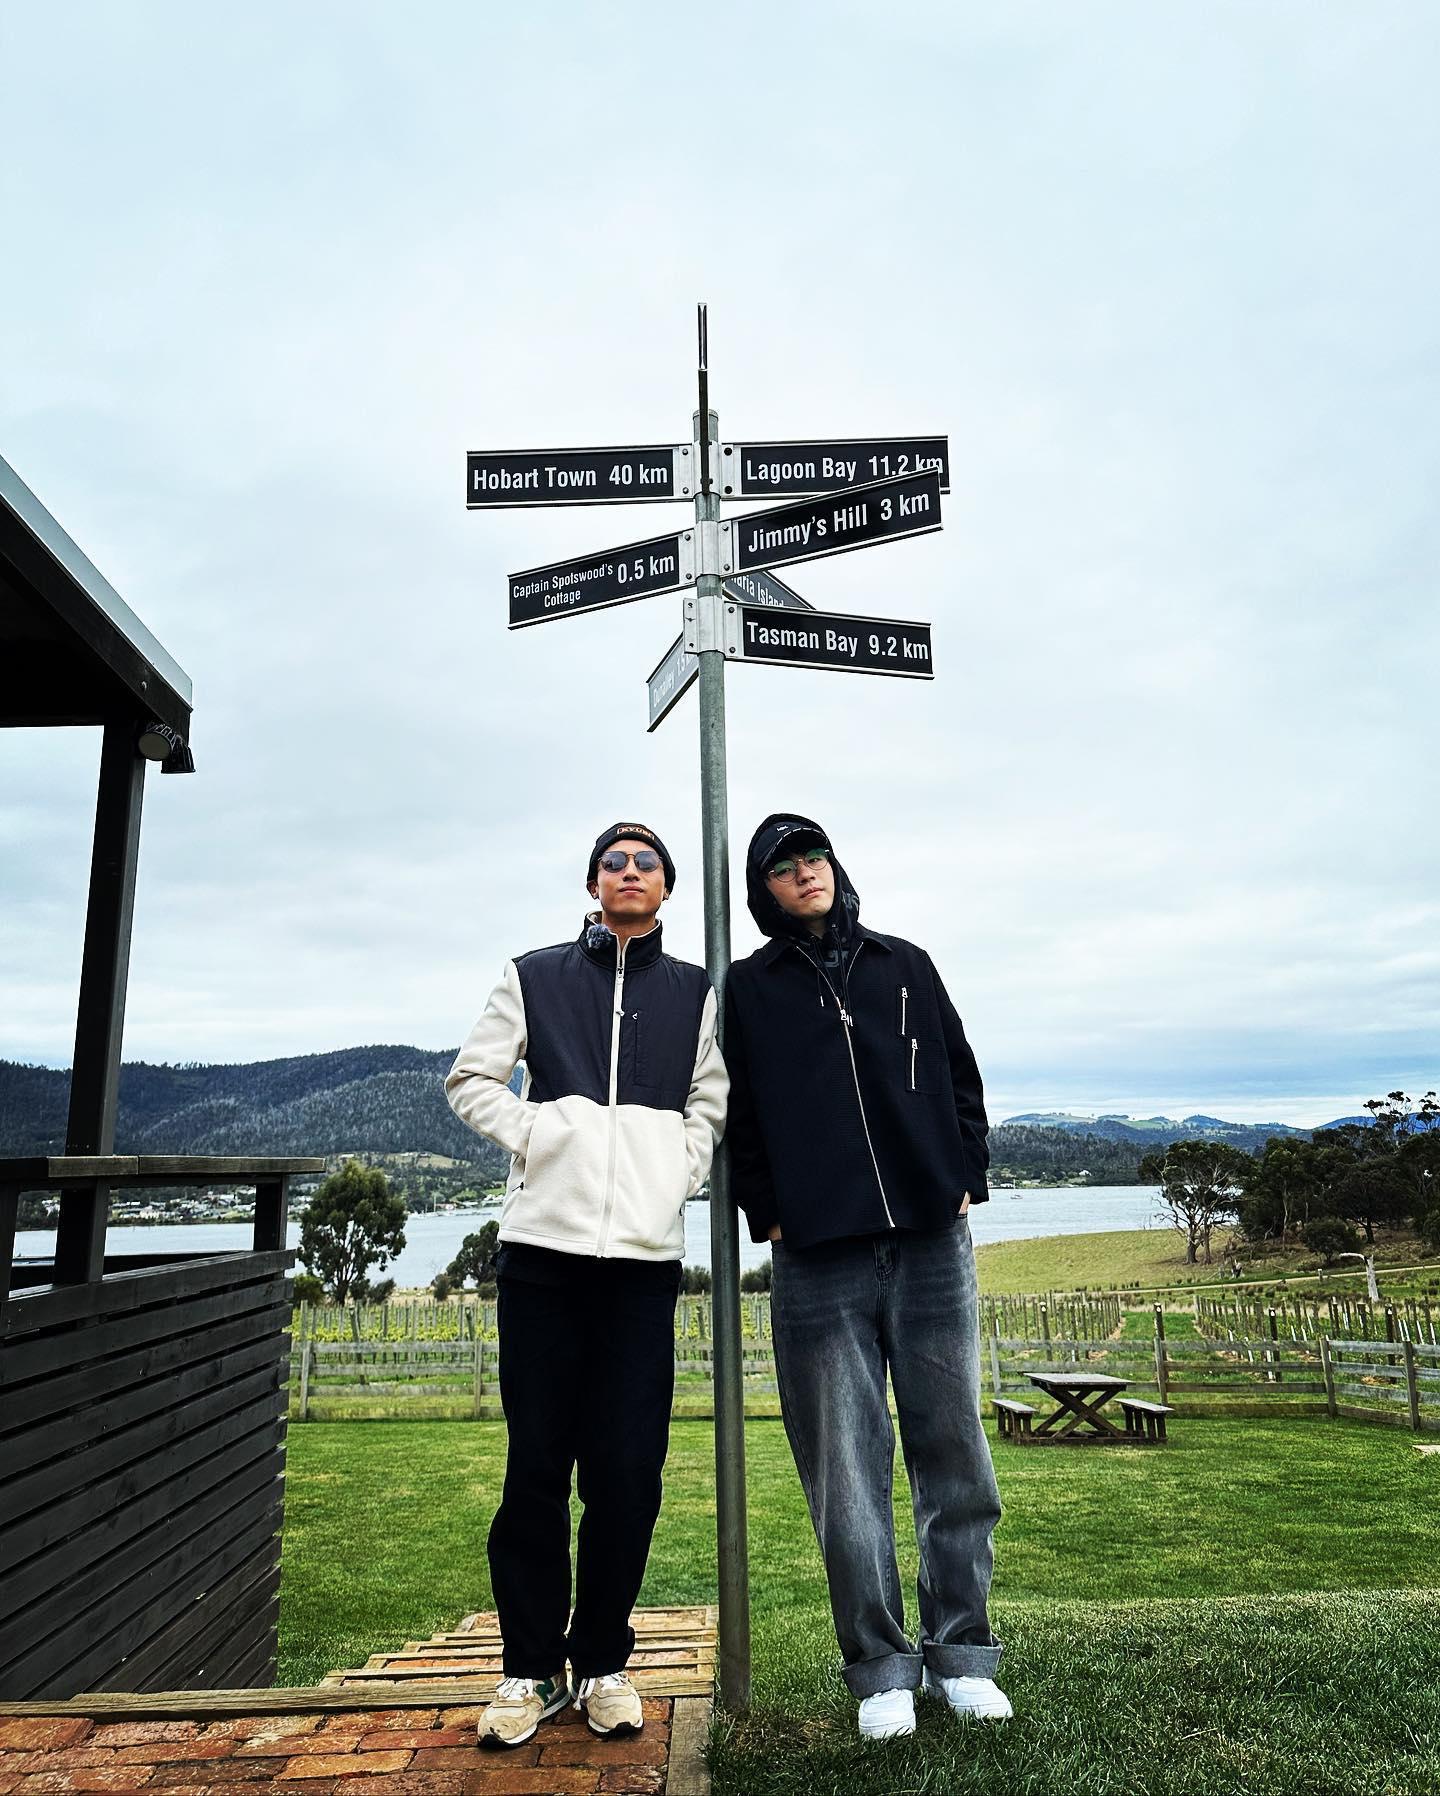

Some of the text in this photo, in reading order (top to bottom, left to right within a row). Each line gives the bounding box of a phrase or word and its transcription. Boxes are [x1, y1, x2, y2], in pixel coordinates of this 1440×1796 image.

[473, 463, 668, 490] Hobart Town 40 km
[746, 453, 944, 484] Lagoon Bay 11.2 km
[748, 492, 930, 552] Jimmy's Hill 3 km
[513, 554, 675, 598] Captain Spotswood's 0.5 km
[731, 575, 755, 597] aria
[543, 589, 581, 608] Cottage
[746, 621, 929, 660] Tasman Bay 9.2 km
